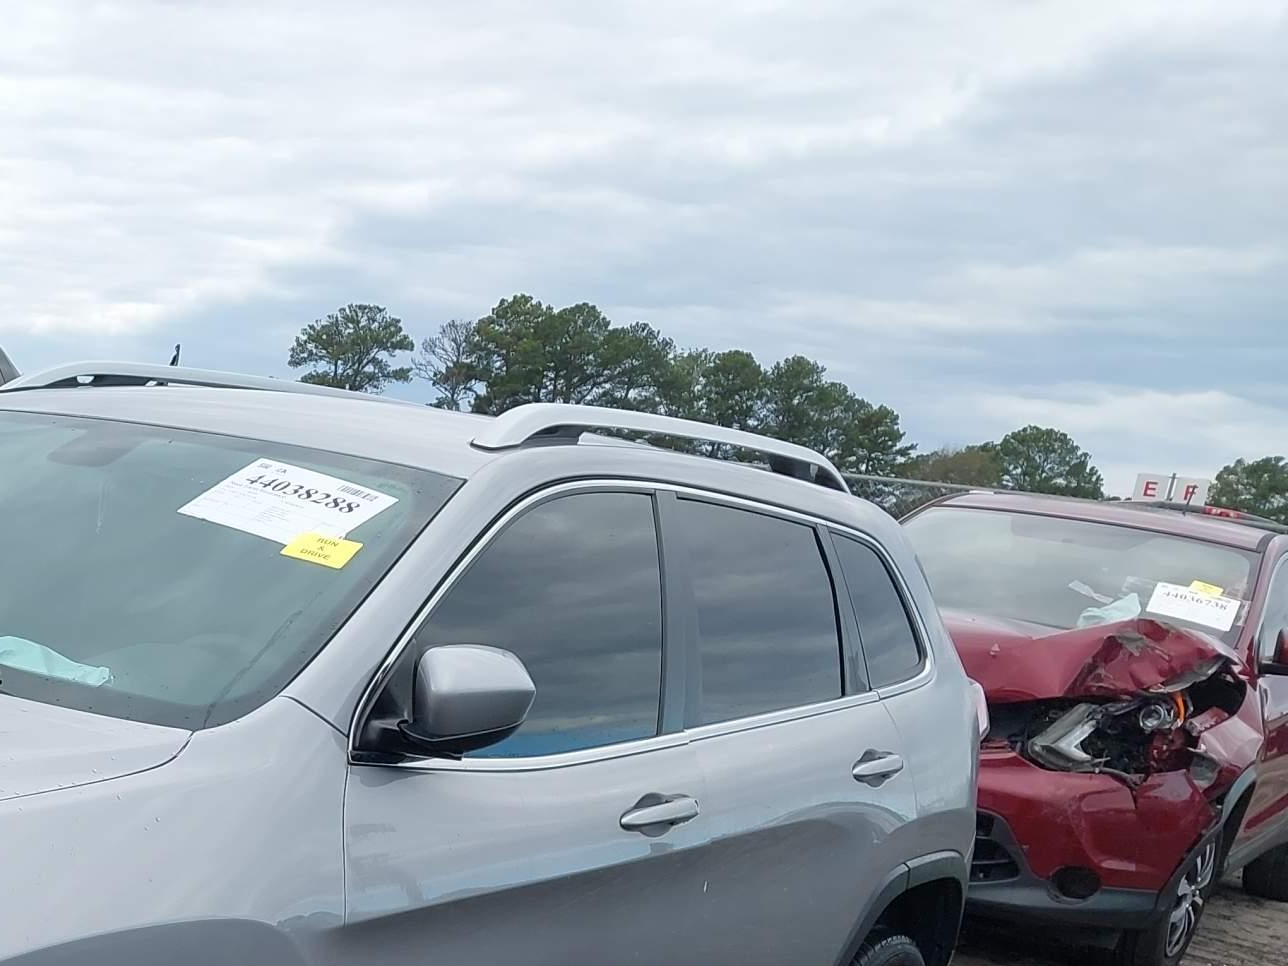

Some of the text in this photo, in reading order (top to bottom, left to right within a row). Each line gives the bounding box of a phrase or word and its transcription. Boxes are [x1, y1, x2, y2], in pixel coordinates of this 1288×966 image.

[245, 474, 361, 514] 44038288
[1143, 481, 1159, 498] E
[316, 537, 340, 547] RUN
[300, 548, 331, 560] DRIVE
